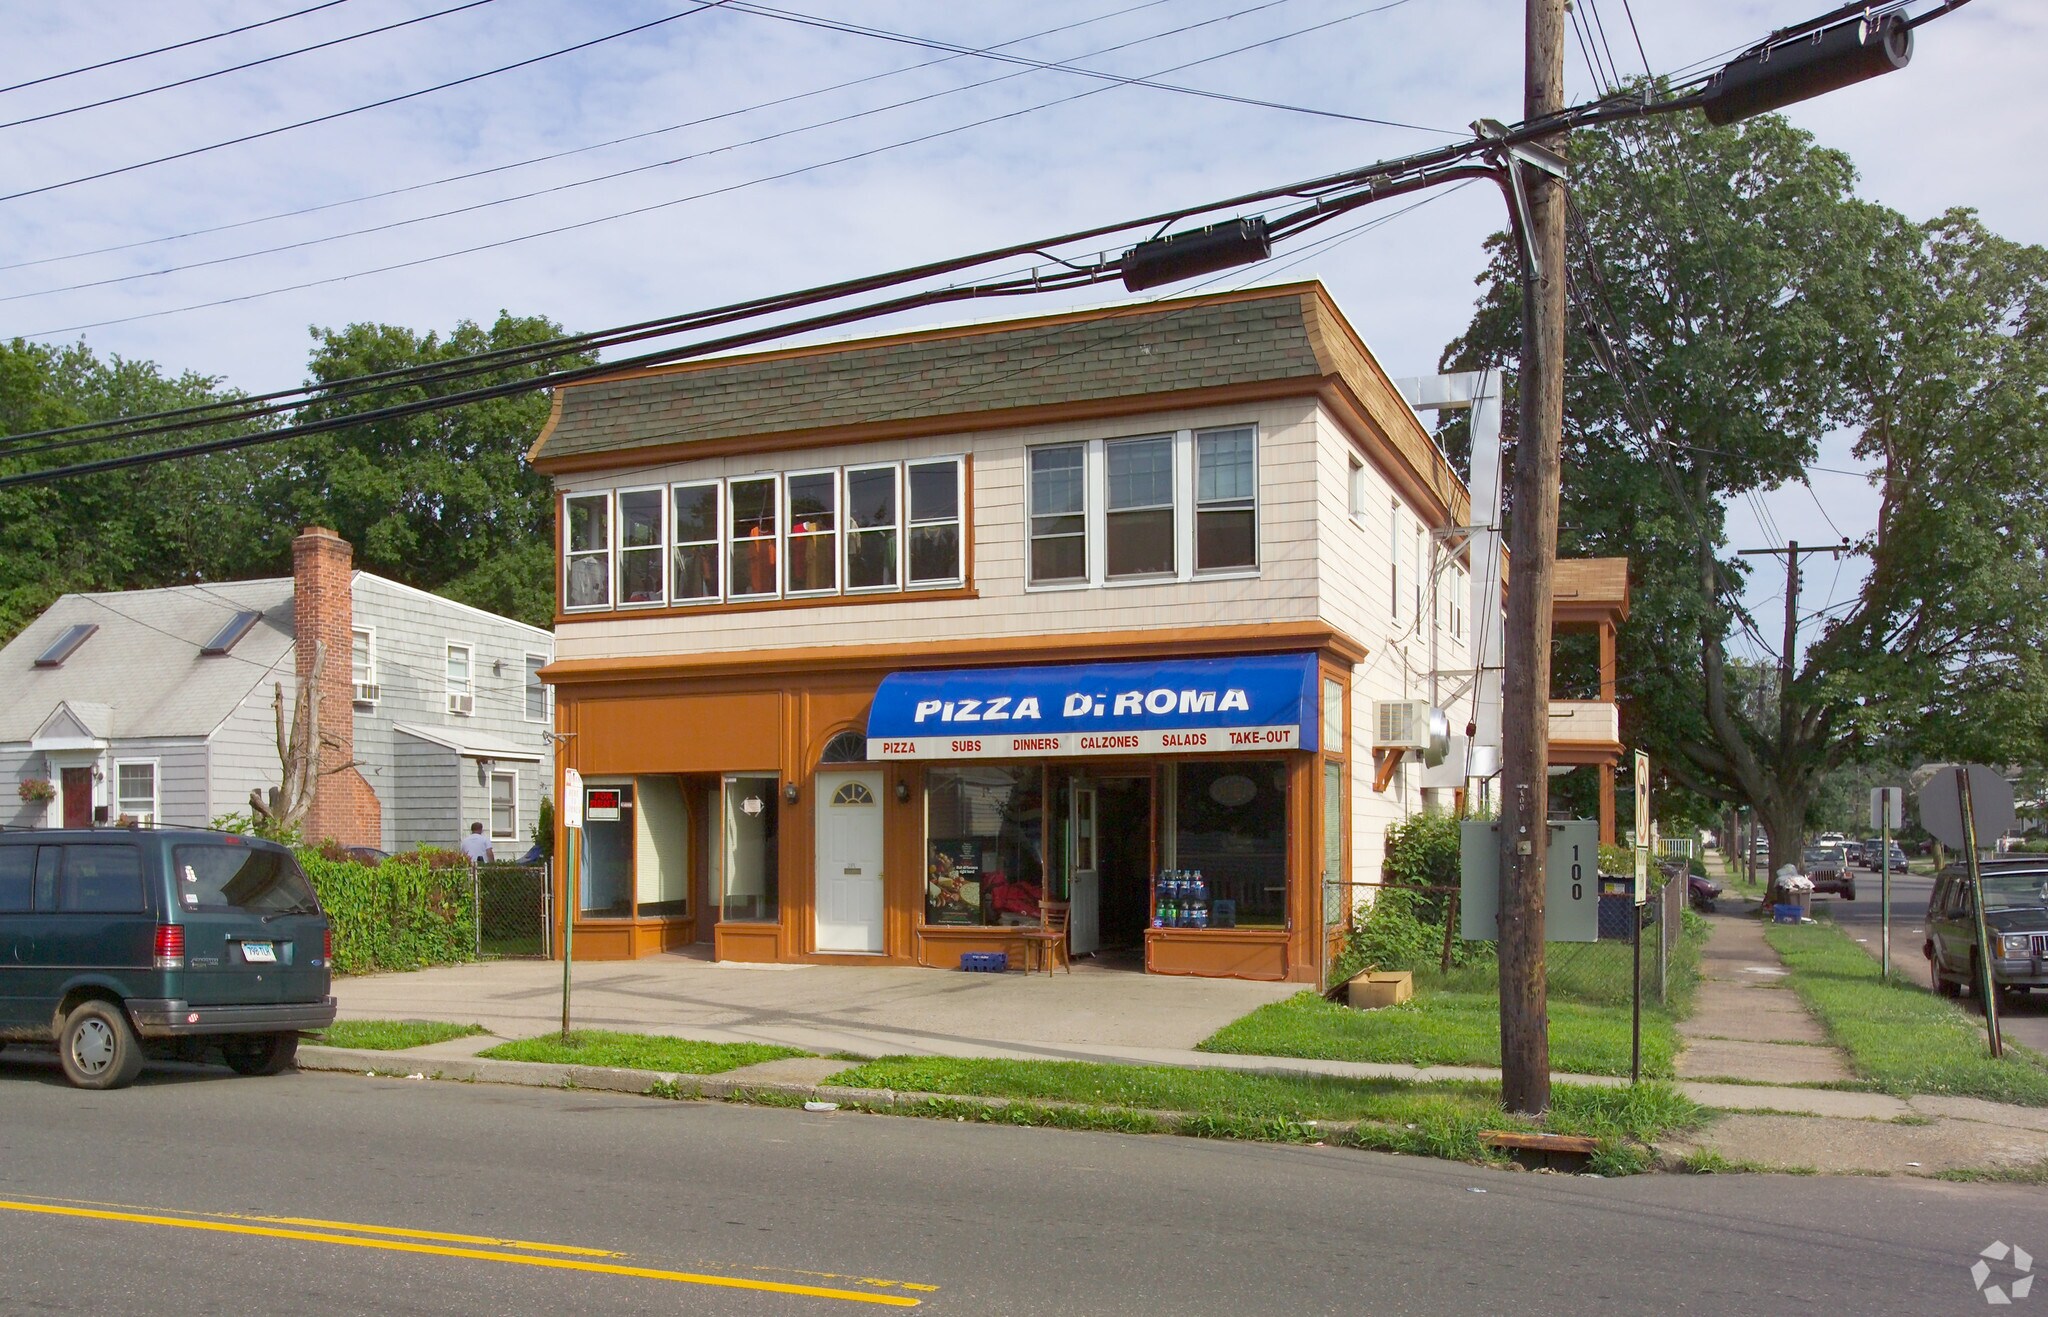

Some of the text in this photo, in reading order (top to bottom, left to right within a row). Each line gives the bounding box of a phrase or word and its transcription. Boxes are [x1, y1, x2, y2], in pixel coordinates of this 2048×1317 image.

[914, 697, 1041, 723] PIZZA
[883, 730, 1291, 754] PIZZA SUBS DINNERS CALZONES SALADS TAKE-OUT
[589, 800, 617, 808] RENT
[594, 792, 613, 800] FOR
[1571, 845, 1582, 900] 100
